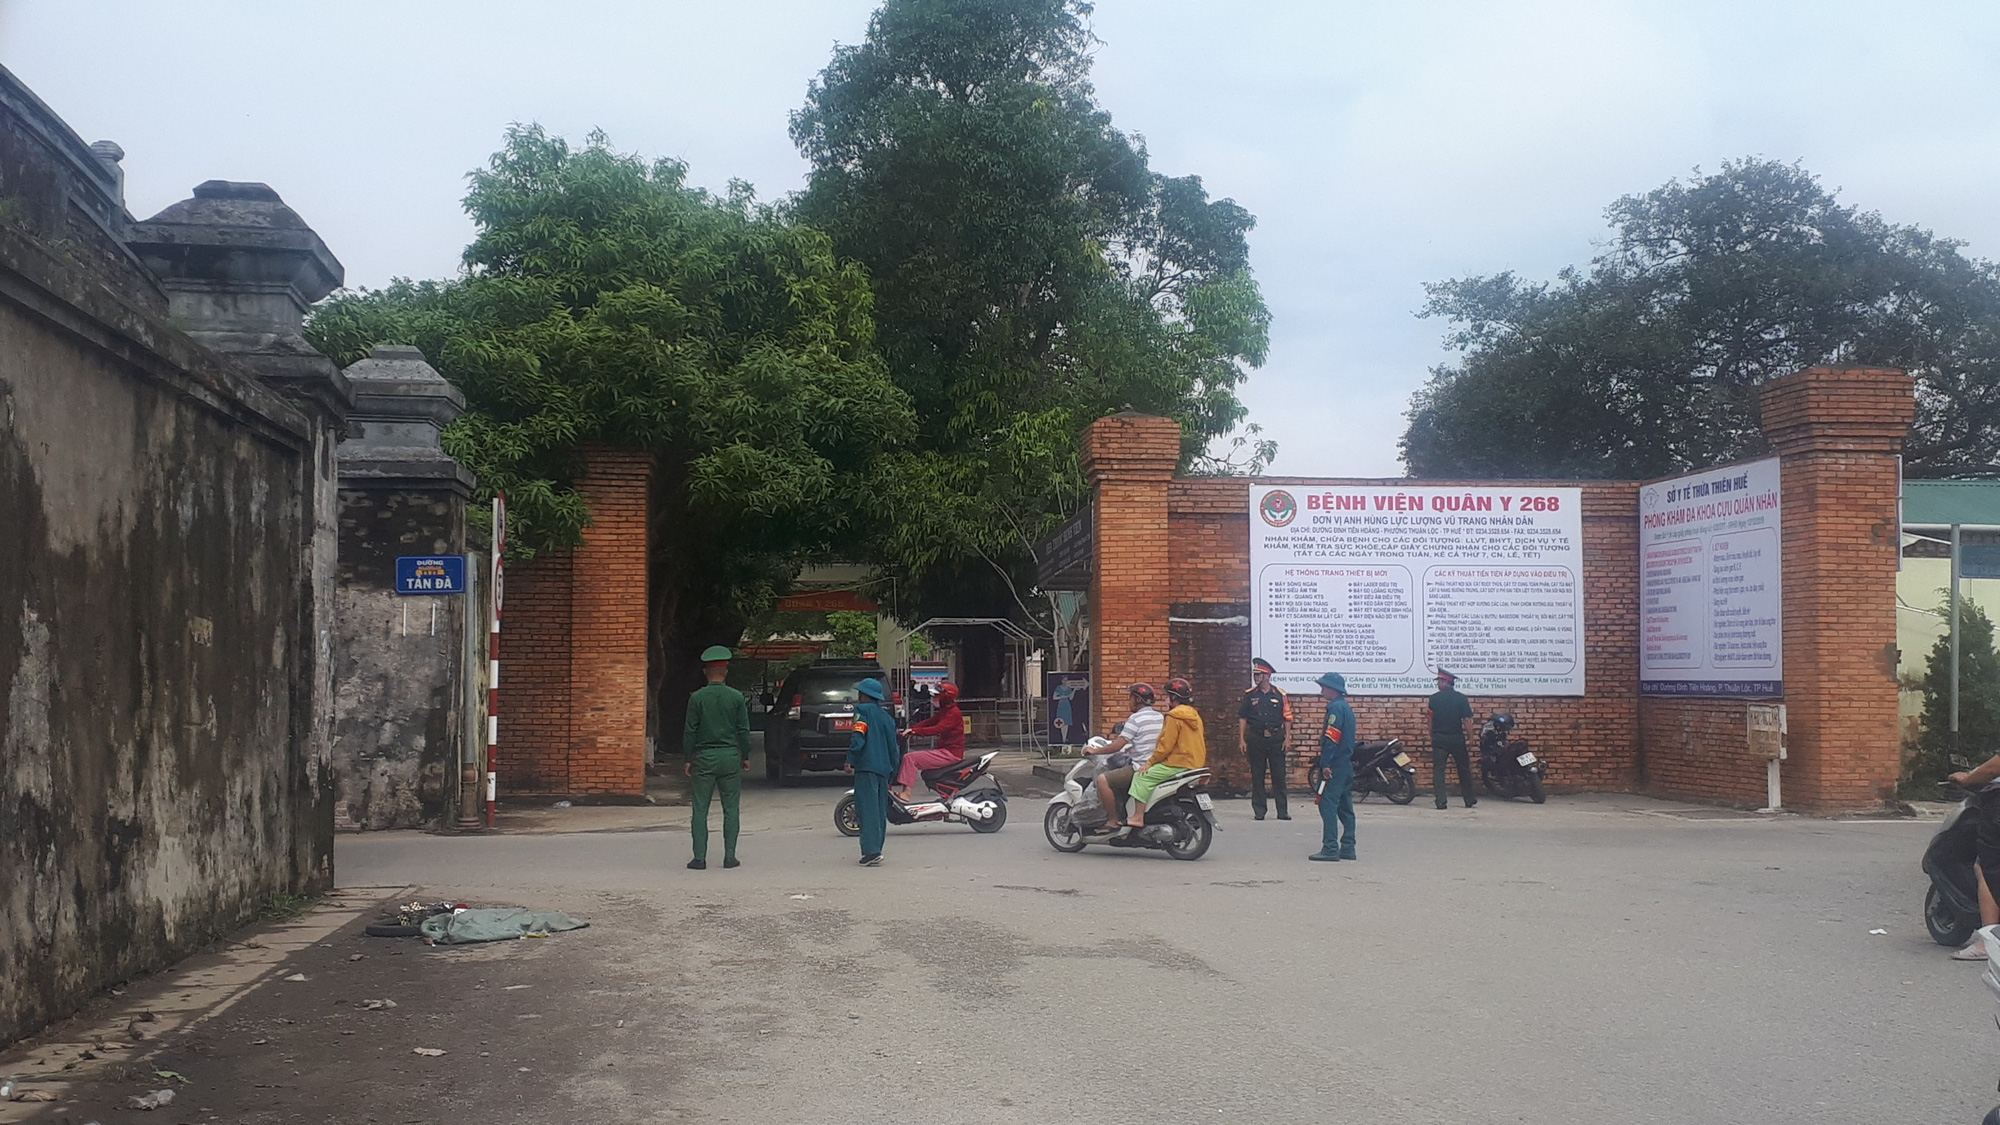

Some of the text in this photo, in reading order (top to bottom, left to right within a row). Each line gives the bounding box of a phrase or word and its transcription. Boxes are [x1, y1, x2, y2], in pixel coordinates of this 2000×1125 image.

[1677, 489, 1680, 501] Y
[1683, 483, 1690, 500] TẾ
[1692, 482, 1709, 499] THỪA
[1711, 478, 1731, 495] THIÊN
[1733, 470, 1748, 492] HUẾ
[1307, 492, 1365, 513] BỆNH
[1374, 492, 1423, 514] VIỆN
[1431, 492, 1491, 513] QUÂN
[1500, 496, 1511, 511] Y
[1520, 496, 1559, 512] 268
[1643, 511, 1665, 529] PHÒNG
[1666, 507, 1685, 526] KHÁM
[1686, 507, 1695, 523] ĐA
[1696, 503, 1715, 521] KHOA
[1717, 500, 1732, 520] CỰU
[1733, 495, 1754, 515] QUÂN
[1756, 490, 1777, 512] NHÂN
[1312, 515, 1533, 526] ĐƠN VỊ ANH HÙNG LỰC LƯỢNG VŨ TRANG NHÂN DÂN
[406, 575, 453, 589] TẢN ĐÀ
